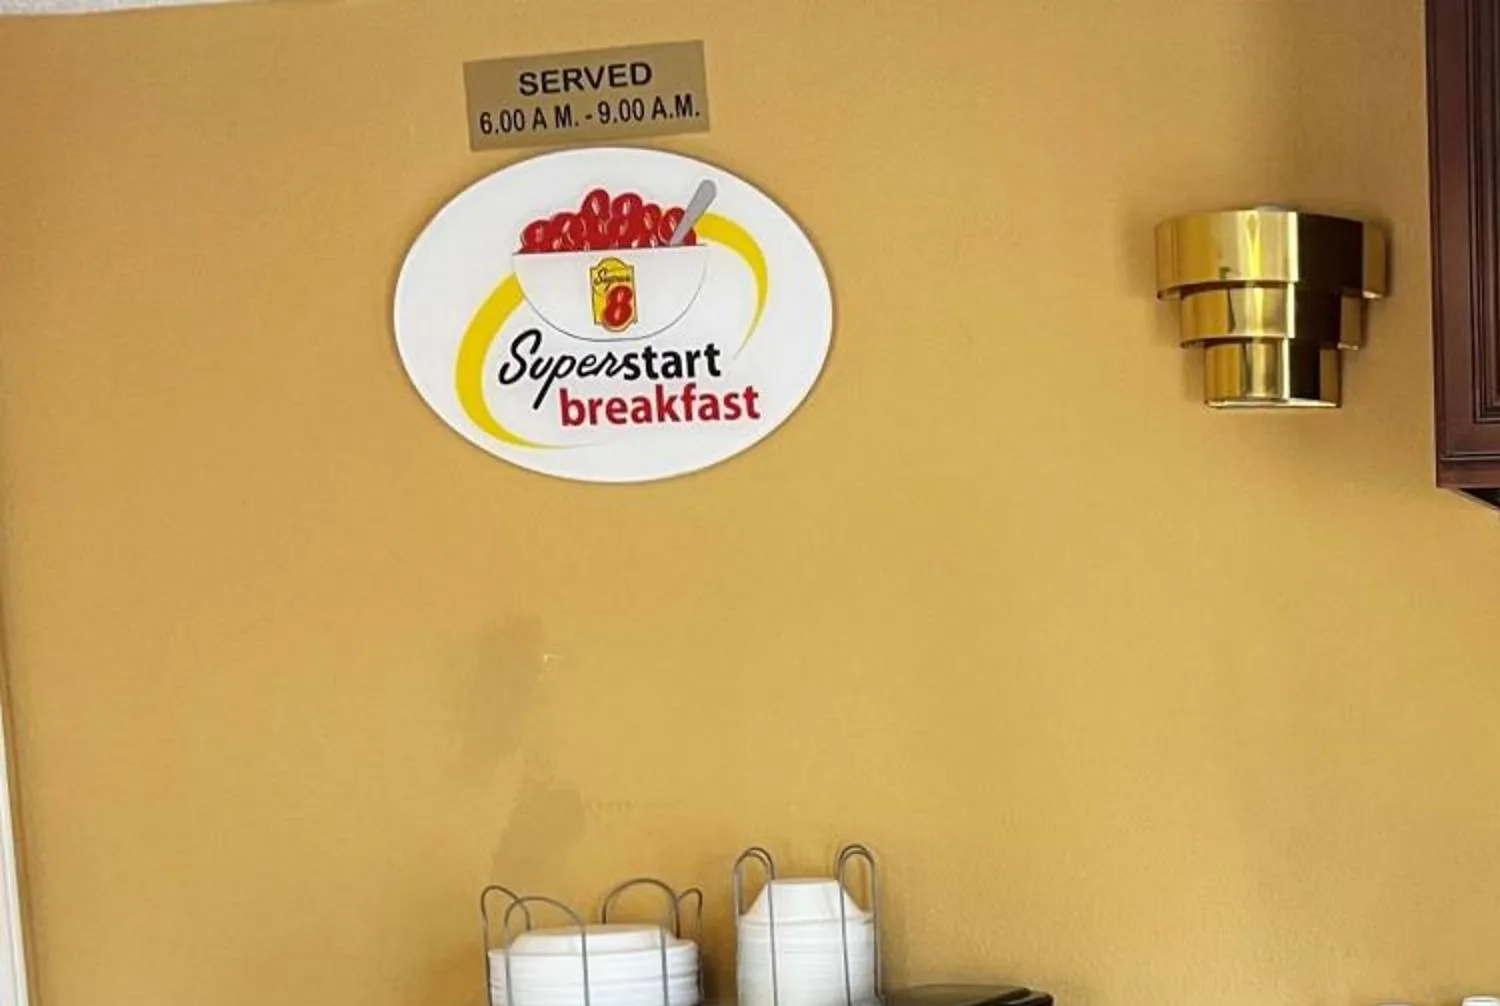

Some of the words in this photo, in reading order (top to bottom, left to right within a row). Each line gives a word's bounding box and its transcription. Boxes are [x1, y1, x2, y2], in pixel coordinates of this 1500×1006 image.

[519, 62, 653, 96] SERVED
[479, 109, 525, 135] 6.00
[598, 98, 645, 124] 9.00
[651, 93, 700, 119] A.M.
[604, 285, 634, 328] 8
[498, 328, 722, 409] Superstart
[559, 382, 761, 427] breakfast
